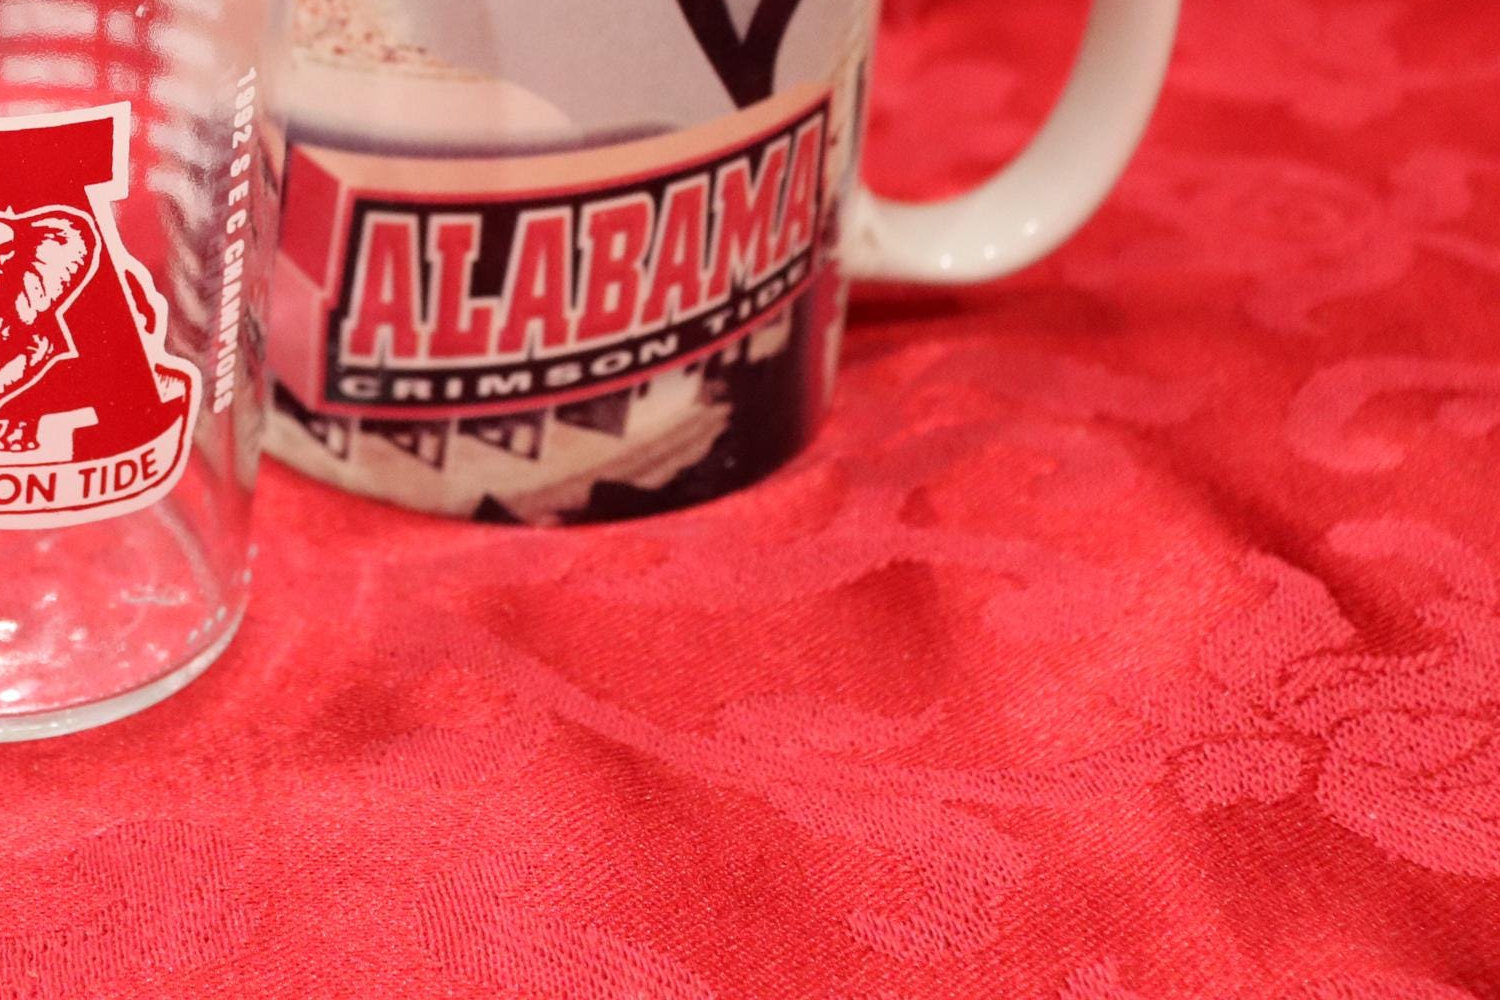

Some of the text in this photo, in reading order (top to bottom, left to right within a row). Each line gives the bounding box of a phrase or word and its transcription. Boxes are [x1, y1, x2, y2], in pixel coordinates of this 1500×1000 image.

[232, 67, 257, 149] 1992
[339, 111, 824, 368] ALABAMA
[213, 239, 245, 413] CHAMPIONS
[339, 260, 812, 400] CRIMSON TIDE
[78, 447, 159, 499] TIDE
